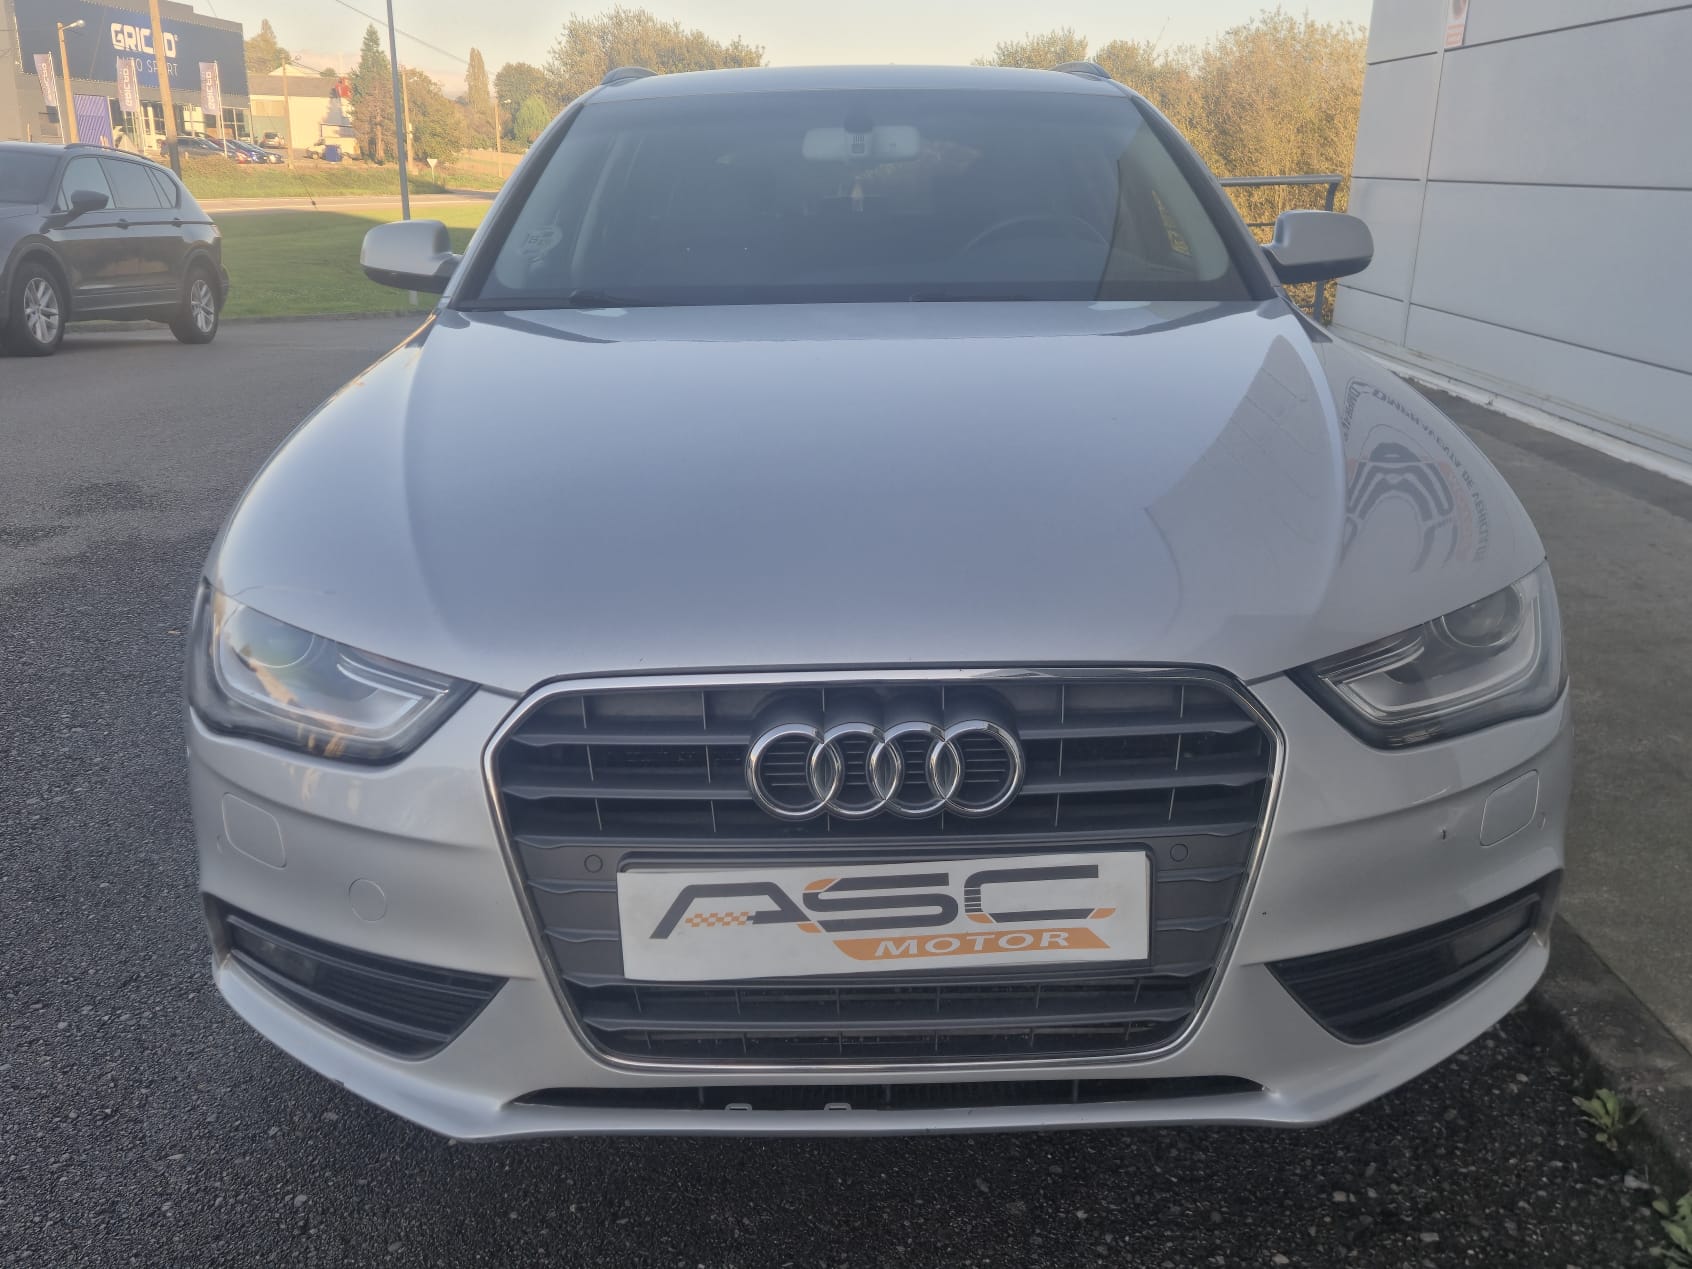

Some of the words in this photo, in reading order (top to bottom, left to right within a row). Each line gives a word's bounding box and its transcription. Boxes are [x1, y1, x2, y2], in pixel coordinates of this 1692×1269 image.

[111, 22, 176, 58] GRICD
[146, 58, 178, 77] SPRT
[649, 864, 1116, 939] ASC
[874, 930, 1071, 958] MOTOR
